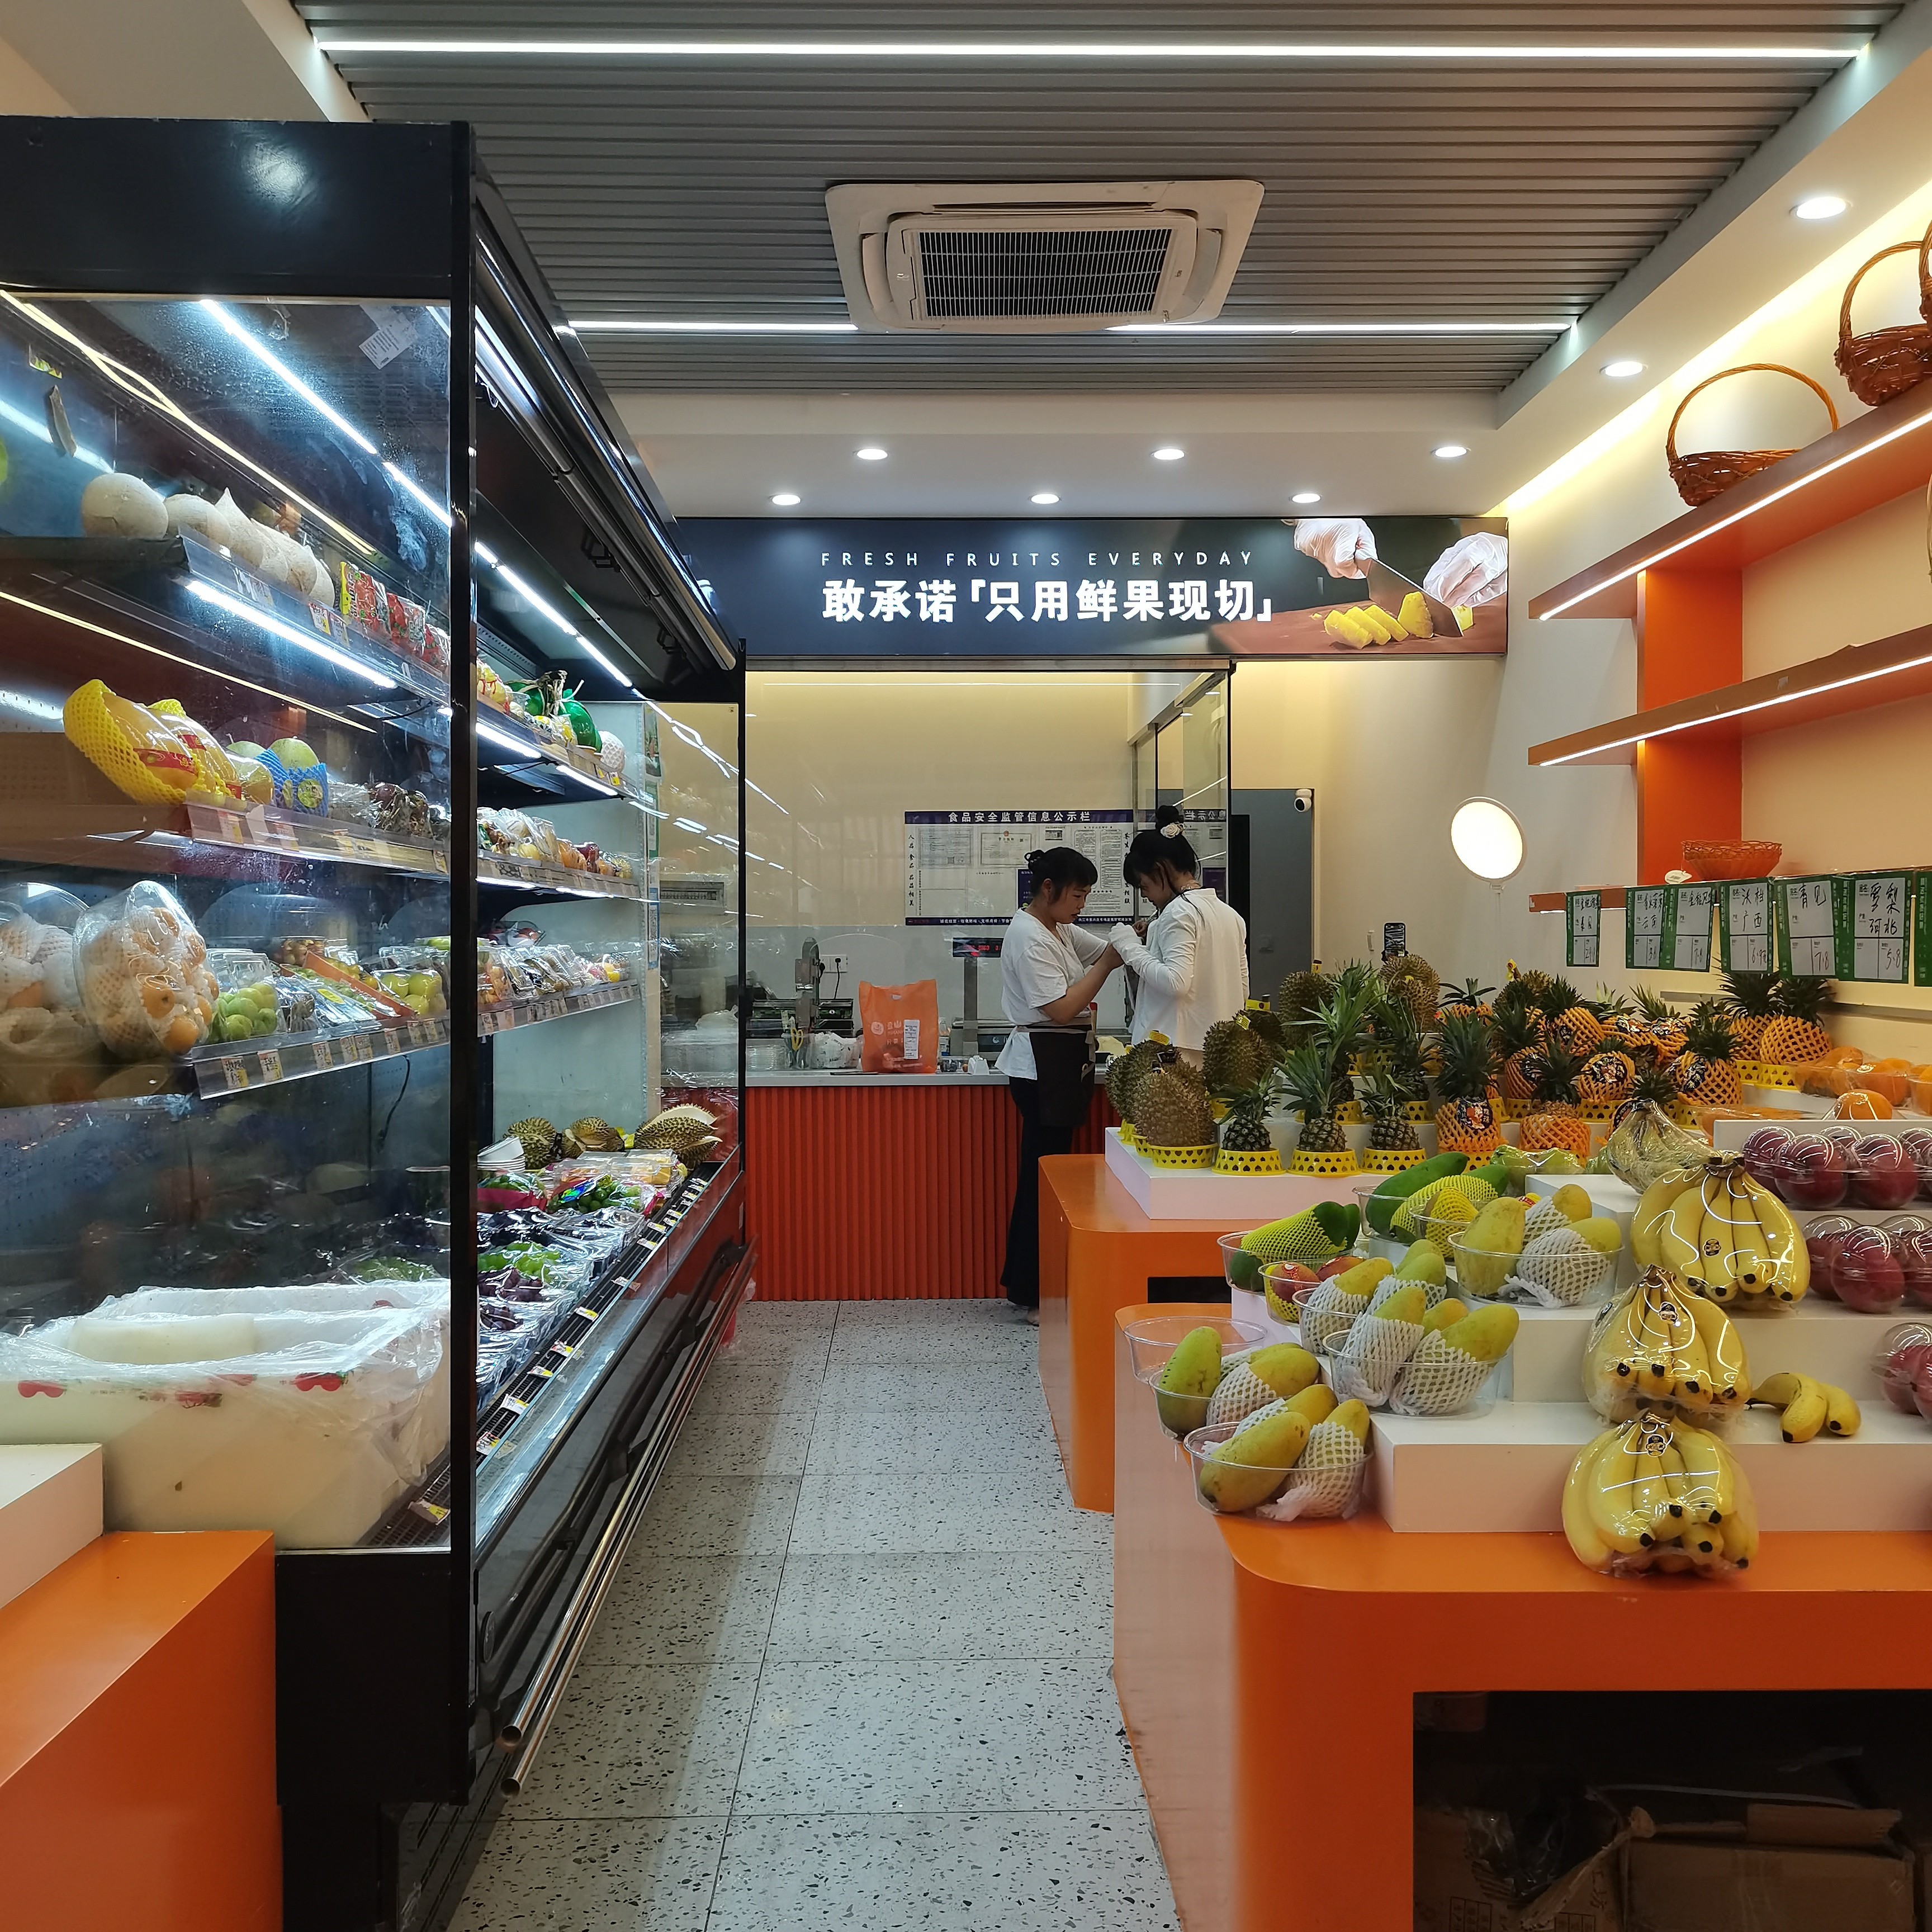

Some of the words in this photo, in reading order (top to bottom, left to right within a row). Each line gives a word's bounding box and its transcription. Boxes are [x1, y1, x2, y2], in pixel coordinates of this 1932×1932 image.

[821, 552, 918, 566] FRESH
[946, 551, 1061, 567] FRUITS
[1087, 550, 1252, 566] EVERYDAY
[948, 812, 1091, 822] 食品安全监管信息公示栏
[1742, 910, 1762, 931] 广西
[1869, 917, 1897, 935] 河北
[1815, 951, 1829, 972] 7.8
[1886, 948, 1901, 969] 5.8
